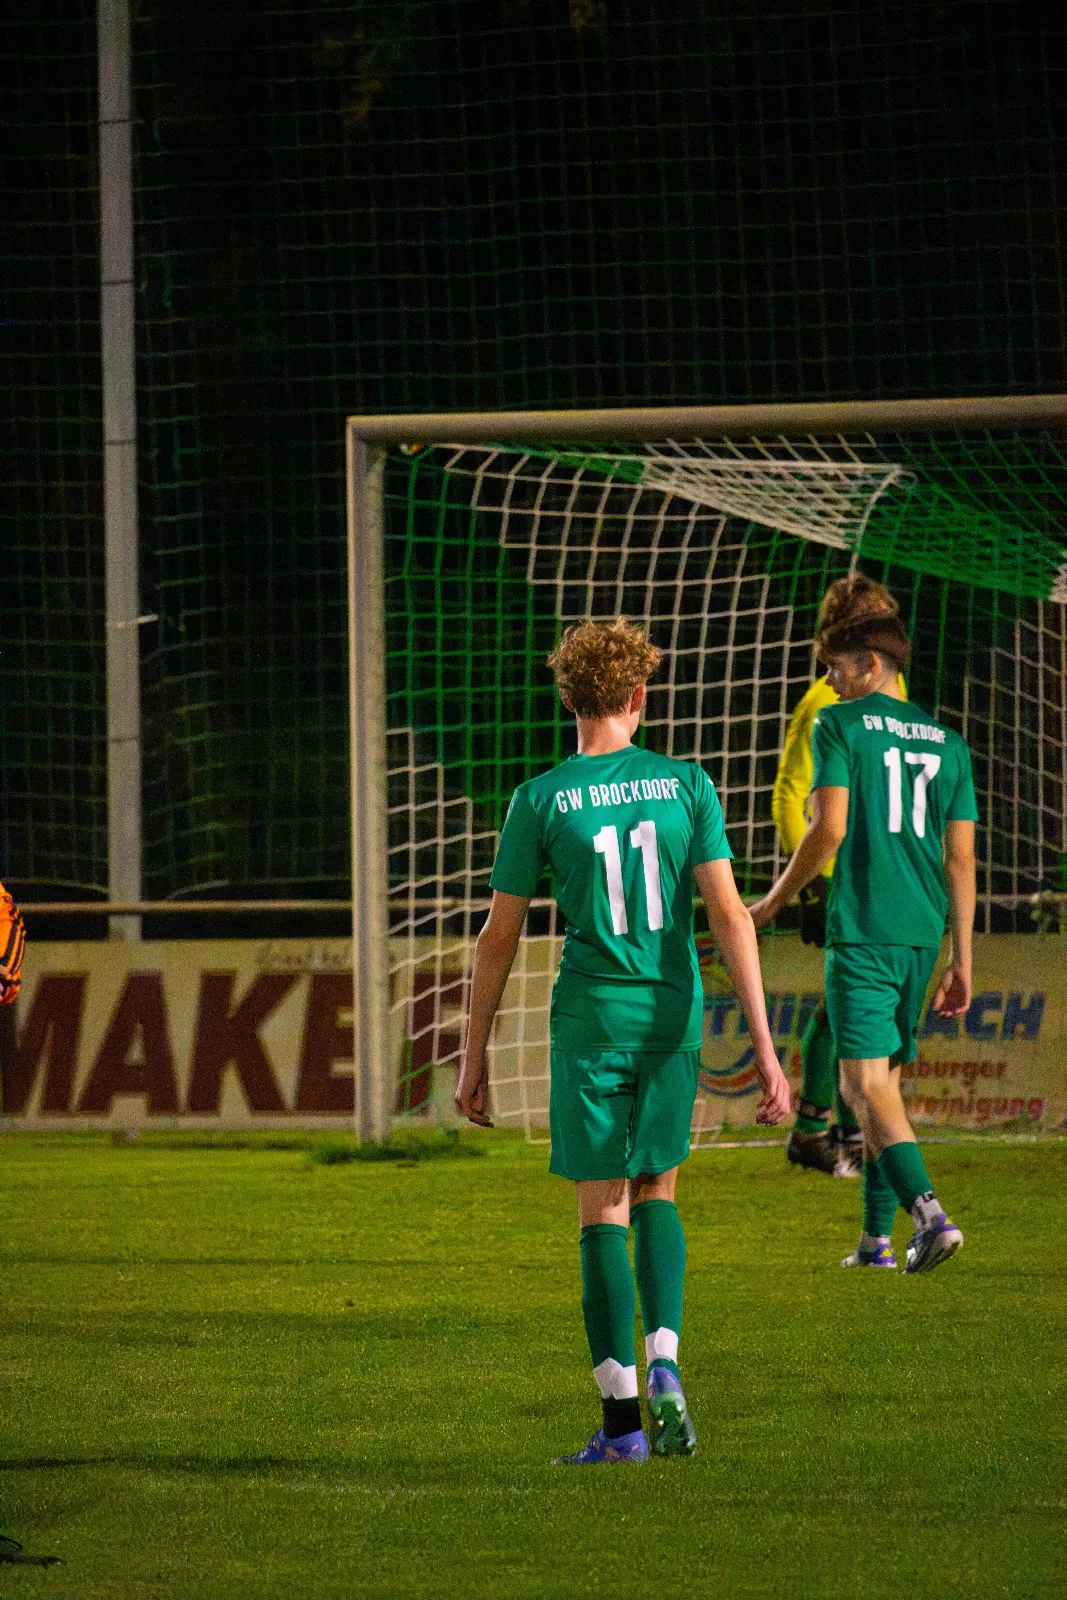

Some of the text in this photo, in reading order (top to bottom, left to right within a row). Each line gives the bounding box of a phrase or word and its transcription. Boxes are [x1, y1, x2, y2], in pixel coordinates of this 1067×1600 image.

[862, 714, 883, 731] GW
[556, 777, 680, 814] GW BROCKDORF
[883, 746, 942, 839] 17
[593, 820, 663, 936] 11
